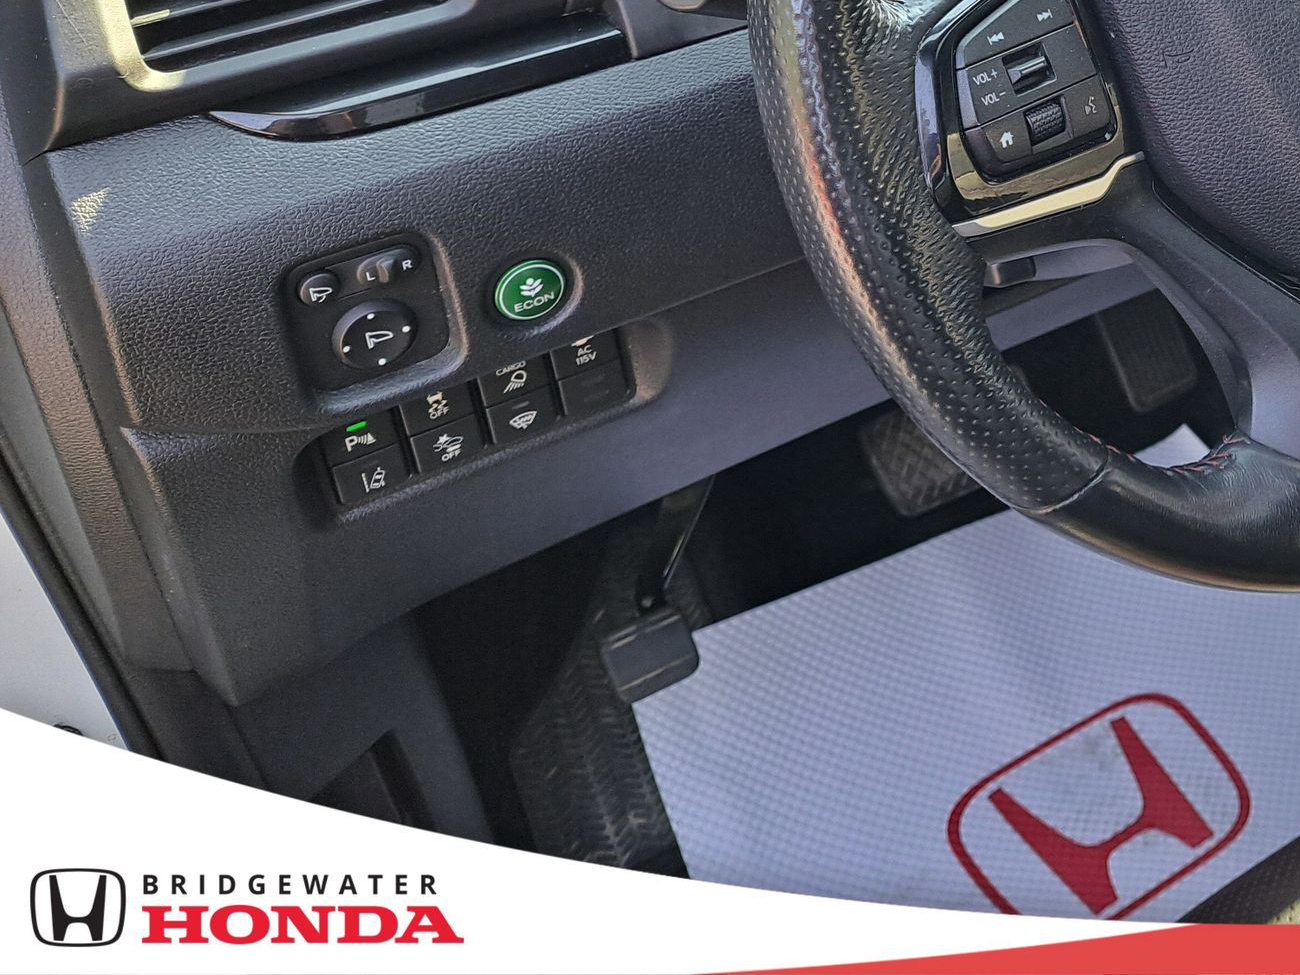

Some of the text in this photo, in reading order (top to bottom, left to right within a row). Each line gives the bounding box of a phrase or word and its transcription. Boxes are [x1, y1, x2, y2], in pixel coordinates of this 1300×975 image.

[401, 259, 414, 271] R
[366, 272, 376, 282] L
[514, 291, 555, 313] ECON
[577, 345, 592, 356] AC
[575, 351, 598, 366] 115V
[495, 361, 526, 376] CARGO
[430, 406, 449, 419] OFF
[441, 449, 462, 462] OFF
